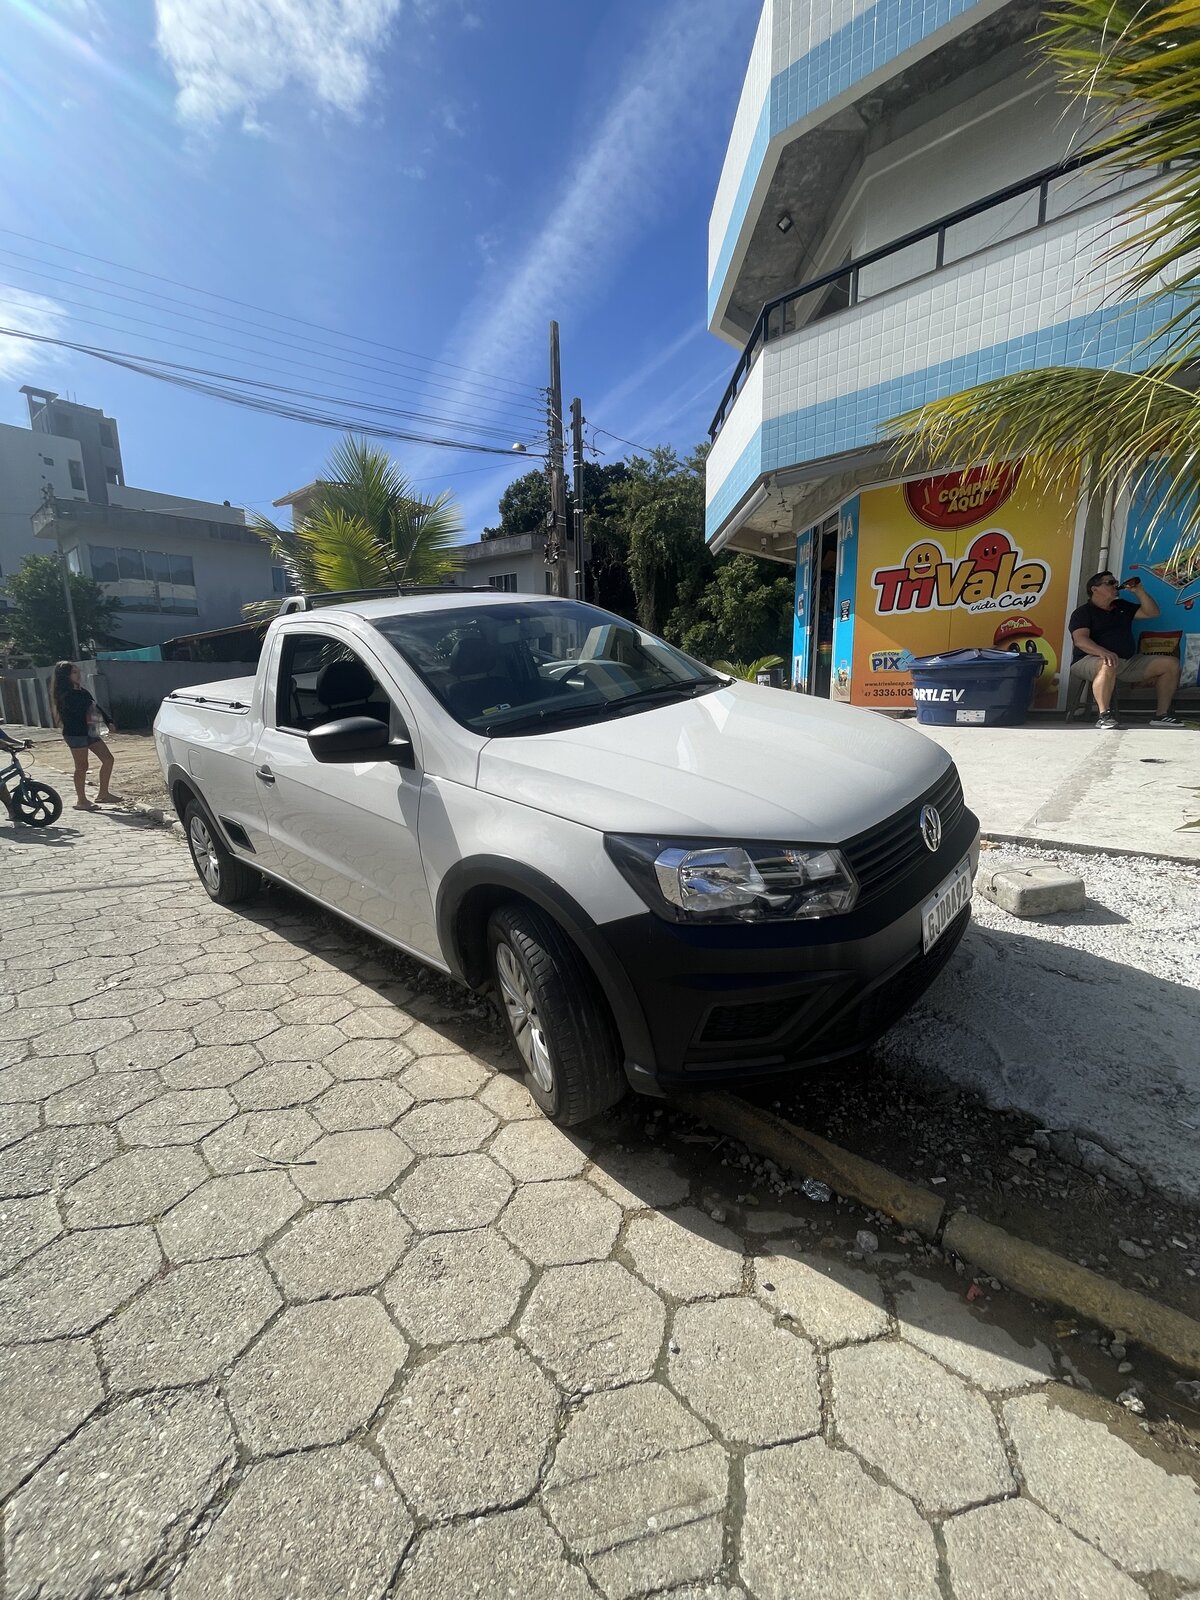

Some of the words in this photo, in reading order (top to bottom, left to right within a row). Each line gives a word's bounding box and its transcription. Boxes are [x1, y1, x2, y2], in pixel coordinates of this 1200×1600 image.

[947, 493, 985, 512] AQUI
[875, 551, 1047, 611] TriVale
[971, 601, 997, 611] vida
[999, 595, 1037, 608] Cap
[872, 657, 901, 671] PIX
[873, 688, 913, 697] 3336.103
[928, 875, 968, 941] GJD8A92
